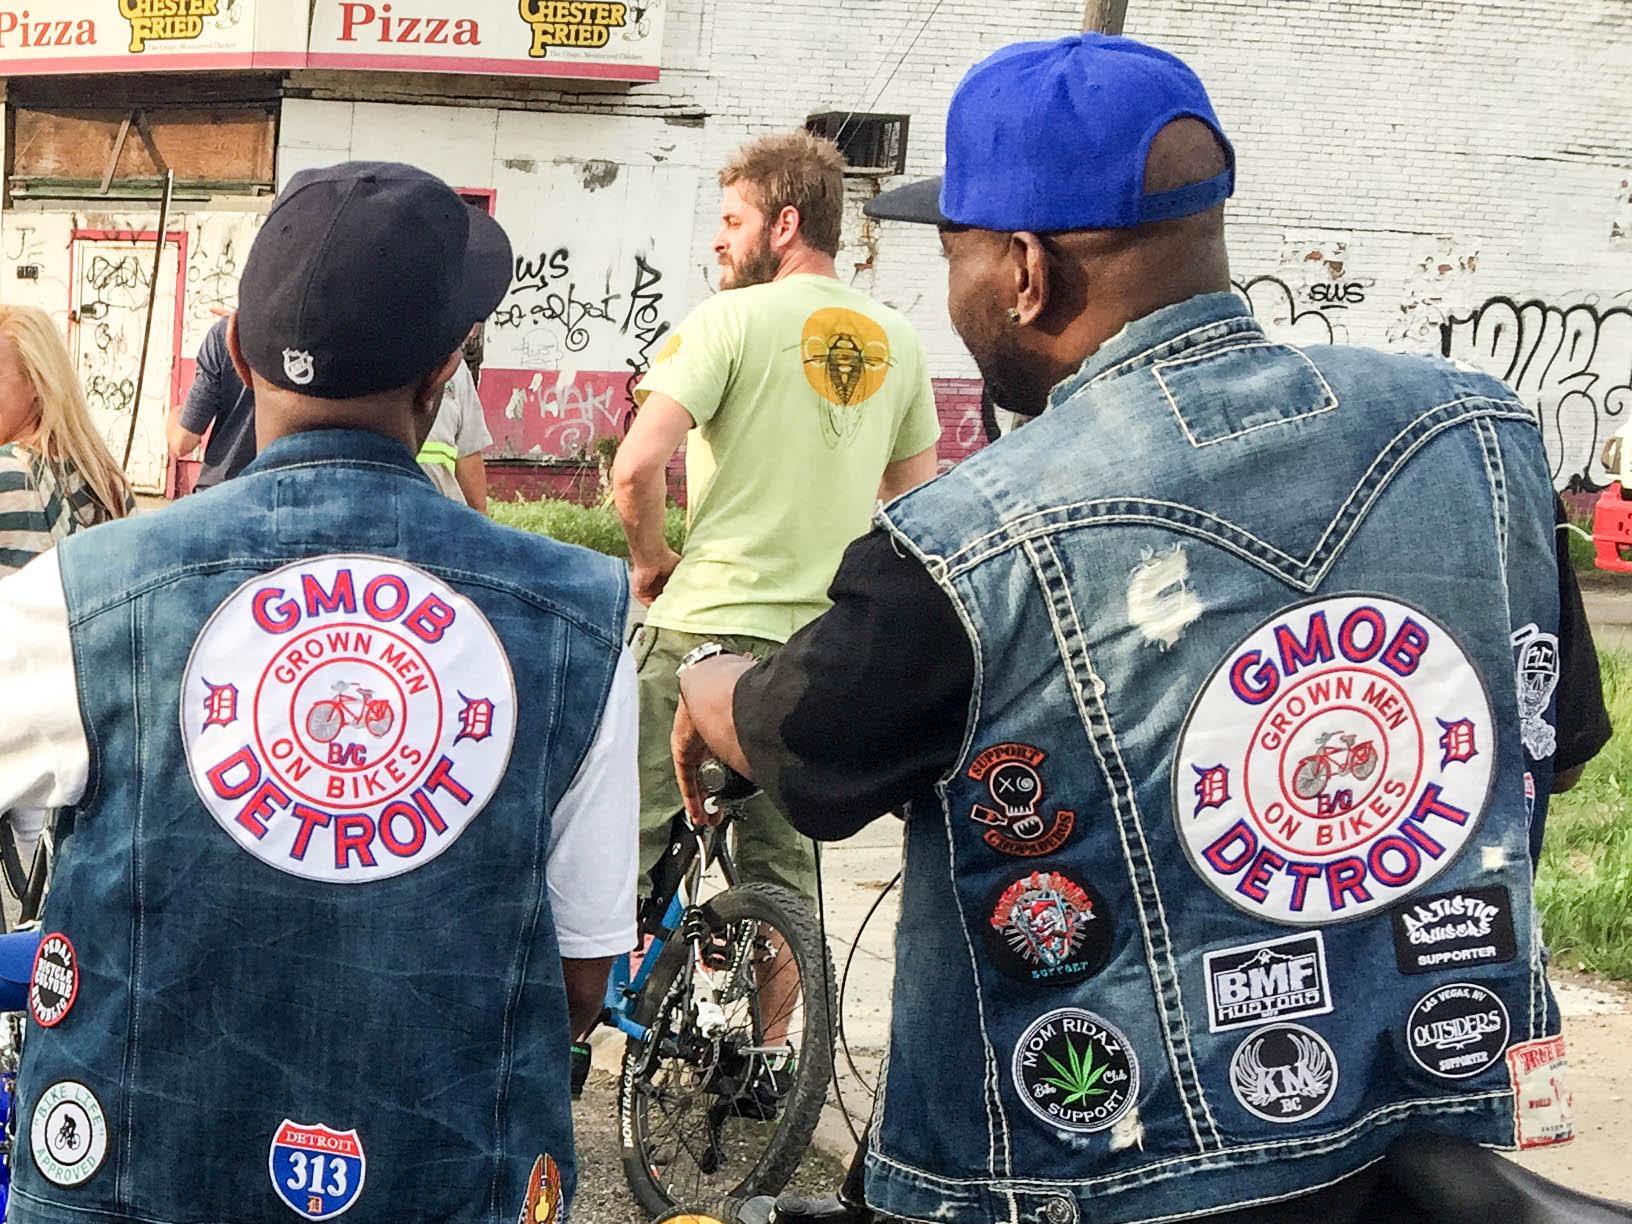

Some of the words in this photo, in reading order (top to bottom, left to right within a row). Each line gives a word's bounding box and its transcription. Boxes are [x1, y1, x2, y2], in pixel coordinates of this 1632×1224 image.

[119, 0, 218, 18] CHESTER
[336, 2, 482, 45] Pizza
[519, 0, 626, 25] CHESTER
[129, 16, 203, 52] FRIED
[529, 22, 609, 57] FRIED
[252, 568, 456, 644] GMOB
[275, 632, 373, 684] GROWN
[379, 643, 428, 695] MEN
[1229, 605, 1430, 705] GMOB
[1261, 676, 1354, 751] GROWN
[1361, 681, 1408, 730] MEN
[272, 738, 312, 783] ON
[327, 745, 421, 798] BIKES
[328, 742, 367, 766] B/C
[205, 744, 474, 869] DETROIT
[1264, 802, 1302, 841] ON
[1316, 779, 1406, 846] BIKES
[1318, 789, 1353, 814] B/C
[1201, 782, 1469, 912] DETROIT
[1402, 895, 1499, 935] ARTISTIC
[38, 957, 73, 984] BICYCLE
[43, 939, 71, 967] PEDAL
[1418, 946, 1496, 966] SUPPORTER
[35, 970, 73, 999] CULTURE
[1218, 956, 1314, 1005] BMF
[32, 985, 68, 1022] REPUBLIC
[1421, 997, 1438, 1013] LAS
[1471, 990, 1487, 1002] NV
[1023, 1023, 1057, 1068] MOM
[1062, 1018, 1120, 1057] RIDAZ
[1414, 1010, 1501, 1046] OUTSIDERS
[1103, 1069, 1128, 1084] Club
[1438, 1051, 1489, 1071] SUPPORTER
[1256, 1063, 1314, 1098] KM
[622, 1053, 636, 1148] BONTRAGER
[1048, 1089, 1127, 1122] SUPPORT
[1280, 1097, 1302, 1114] BC
[285, 1130, 354, 1153] DETROIT
[35, 1147, 97, 1182] APPROVED
[287, 1151, 348, 1197] 313
